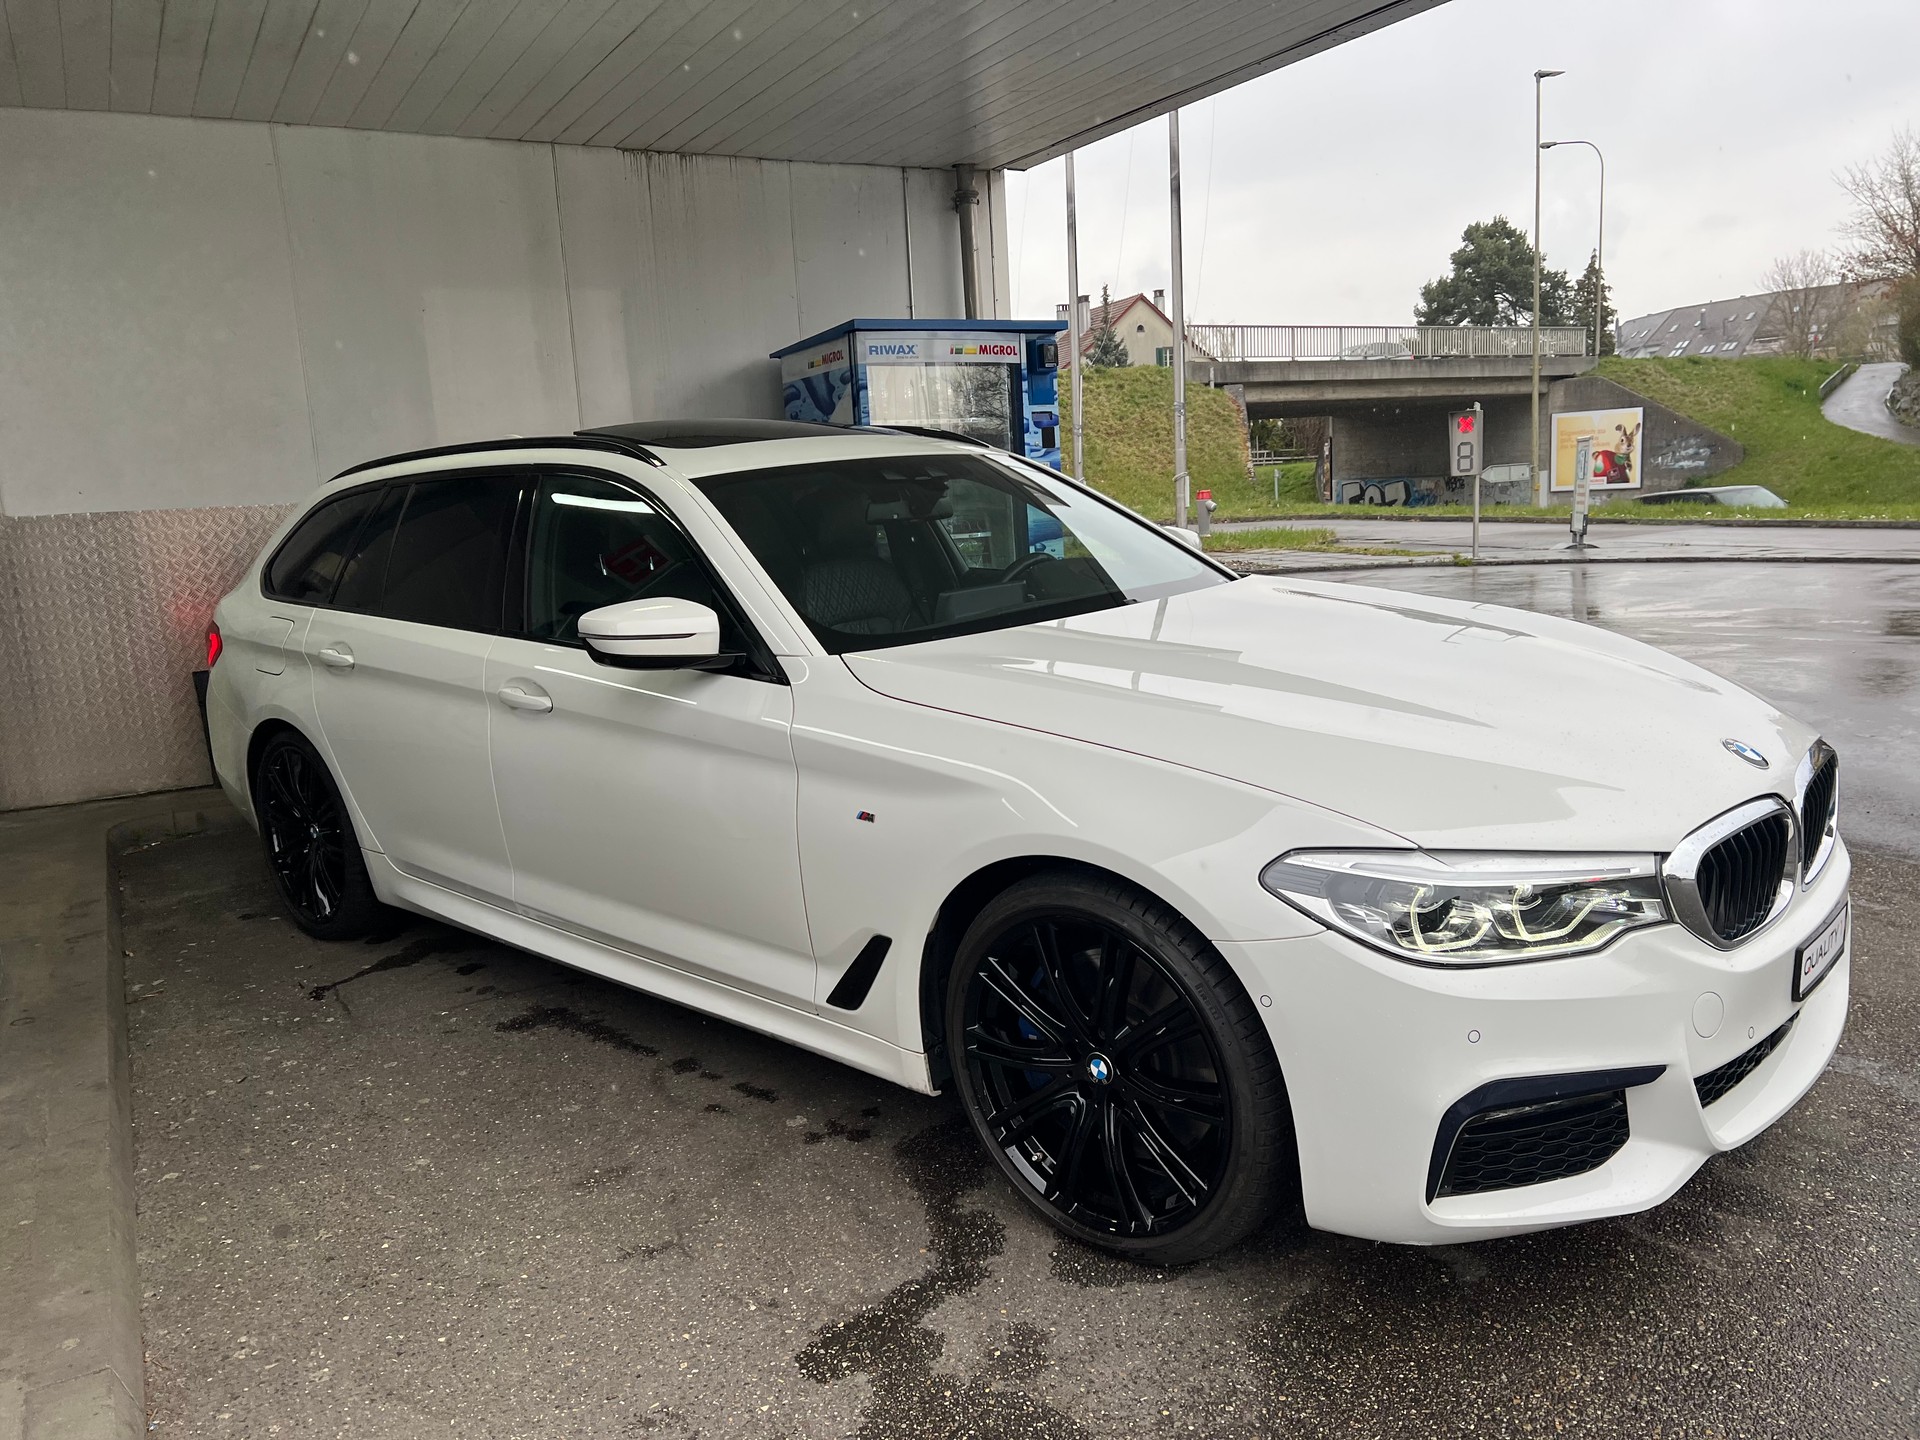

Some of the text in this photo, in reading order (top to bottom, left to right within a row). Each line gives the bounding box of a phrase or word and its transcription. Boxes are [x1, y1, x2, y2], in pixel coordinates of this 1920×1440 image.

[868, 344, 917, 356] RIWAX
[978, 344, 1018, 356] MIGROL
[821, 349, 844, 366] MIGROL
[1803, 923, 1840, 976] QUALITY
